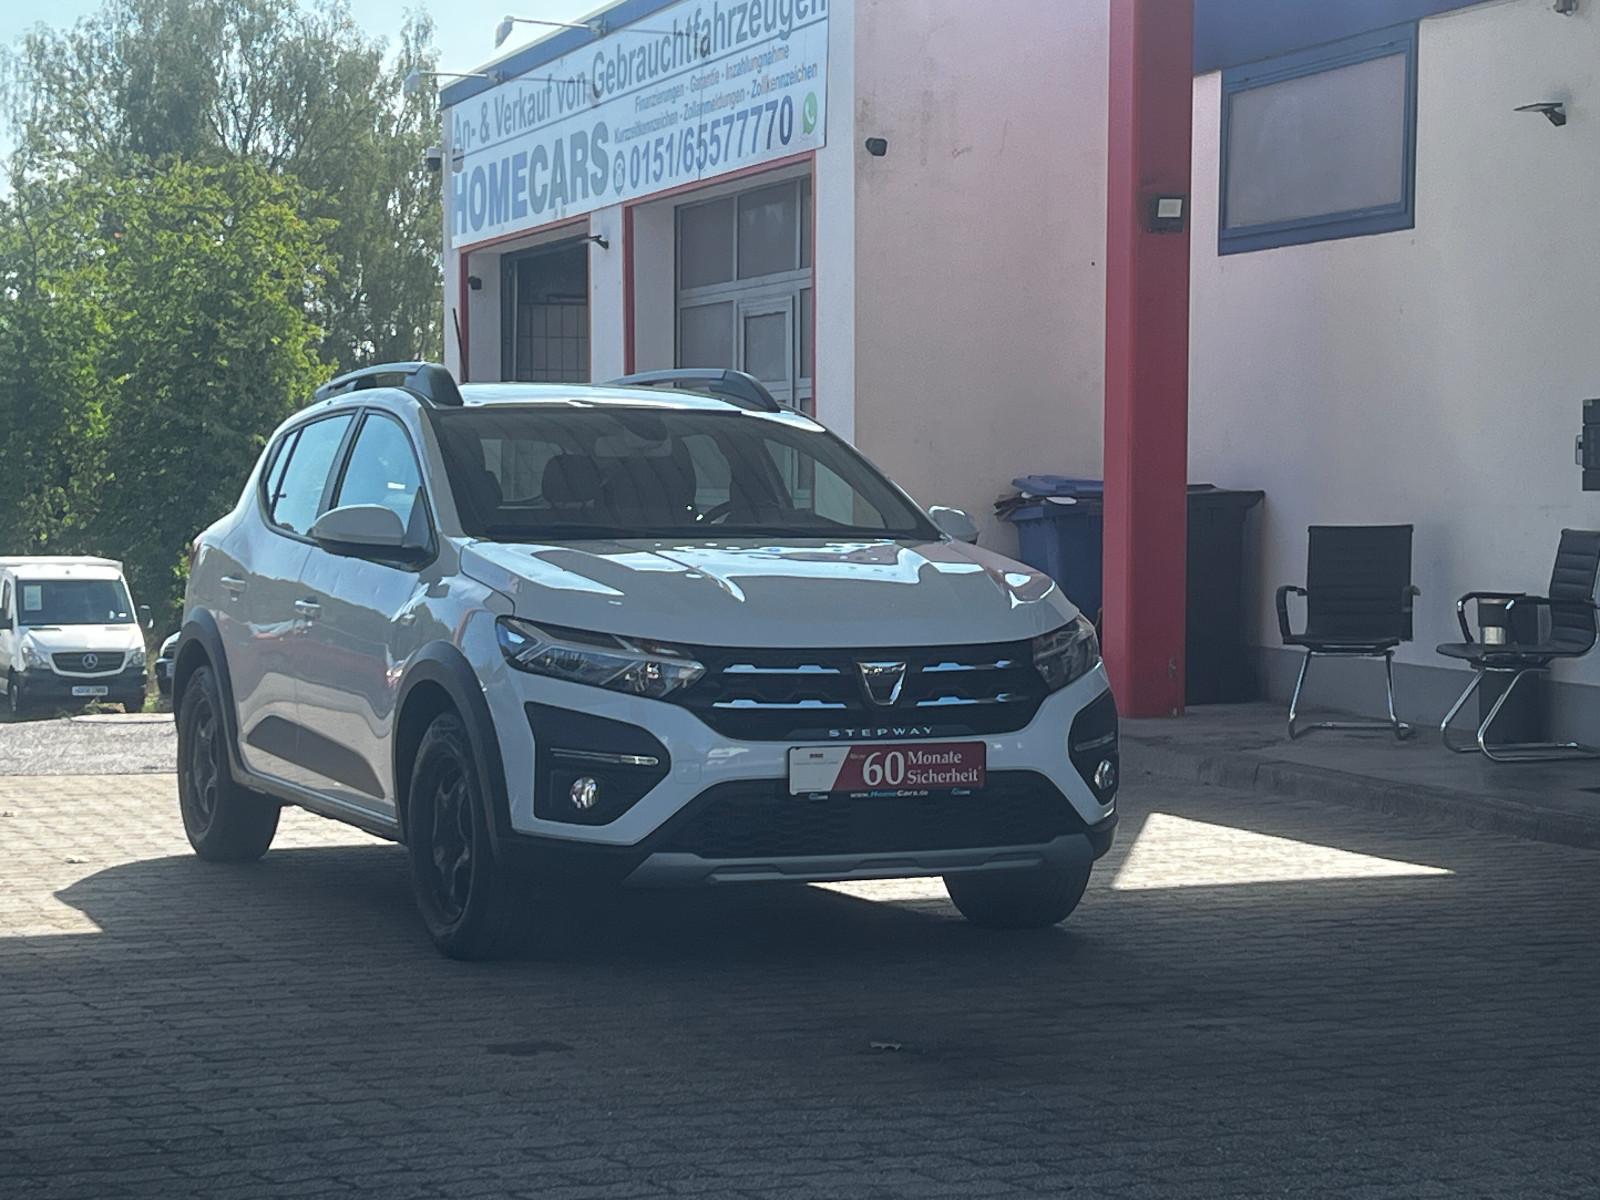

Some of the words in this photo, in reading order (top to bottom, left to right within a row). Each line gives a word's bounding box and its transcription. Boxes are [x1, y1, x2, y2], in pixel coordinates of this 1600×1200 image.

[452, 113, 476, 154] An-
[480, 101, 490, 144] &
[494, 73, 553, 138] Verkauf
[556, 71, 586, 114] von
[451, 121, 609, 236] HOMECARS
[630, 95, 793, 189] 0151/65577770
[828, 726, 933, 737] STEPWAY
[862, 751, 905, 786] 60
[907, 750, 962, 765] Monate
